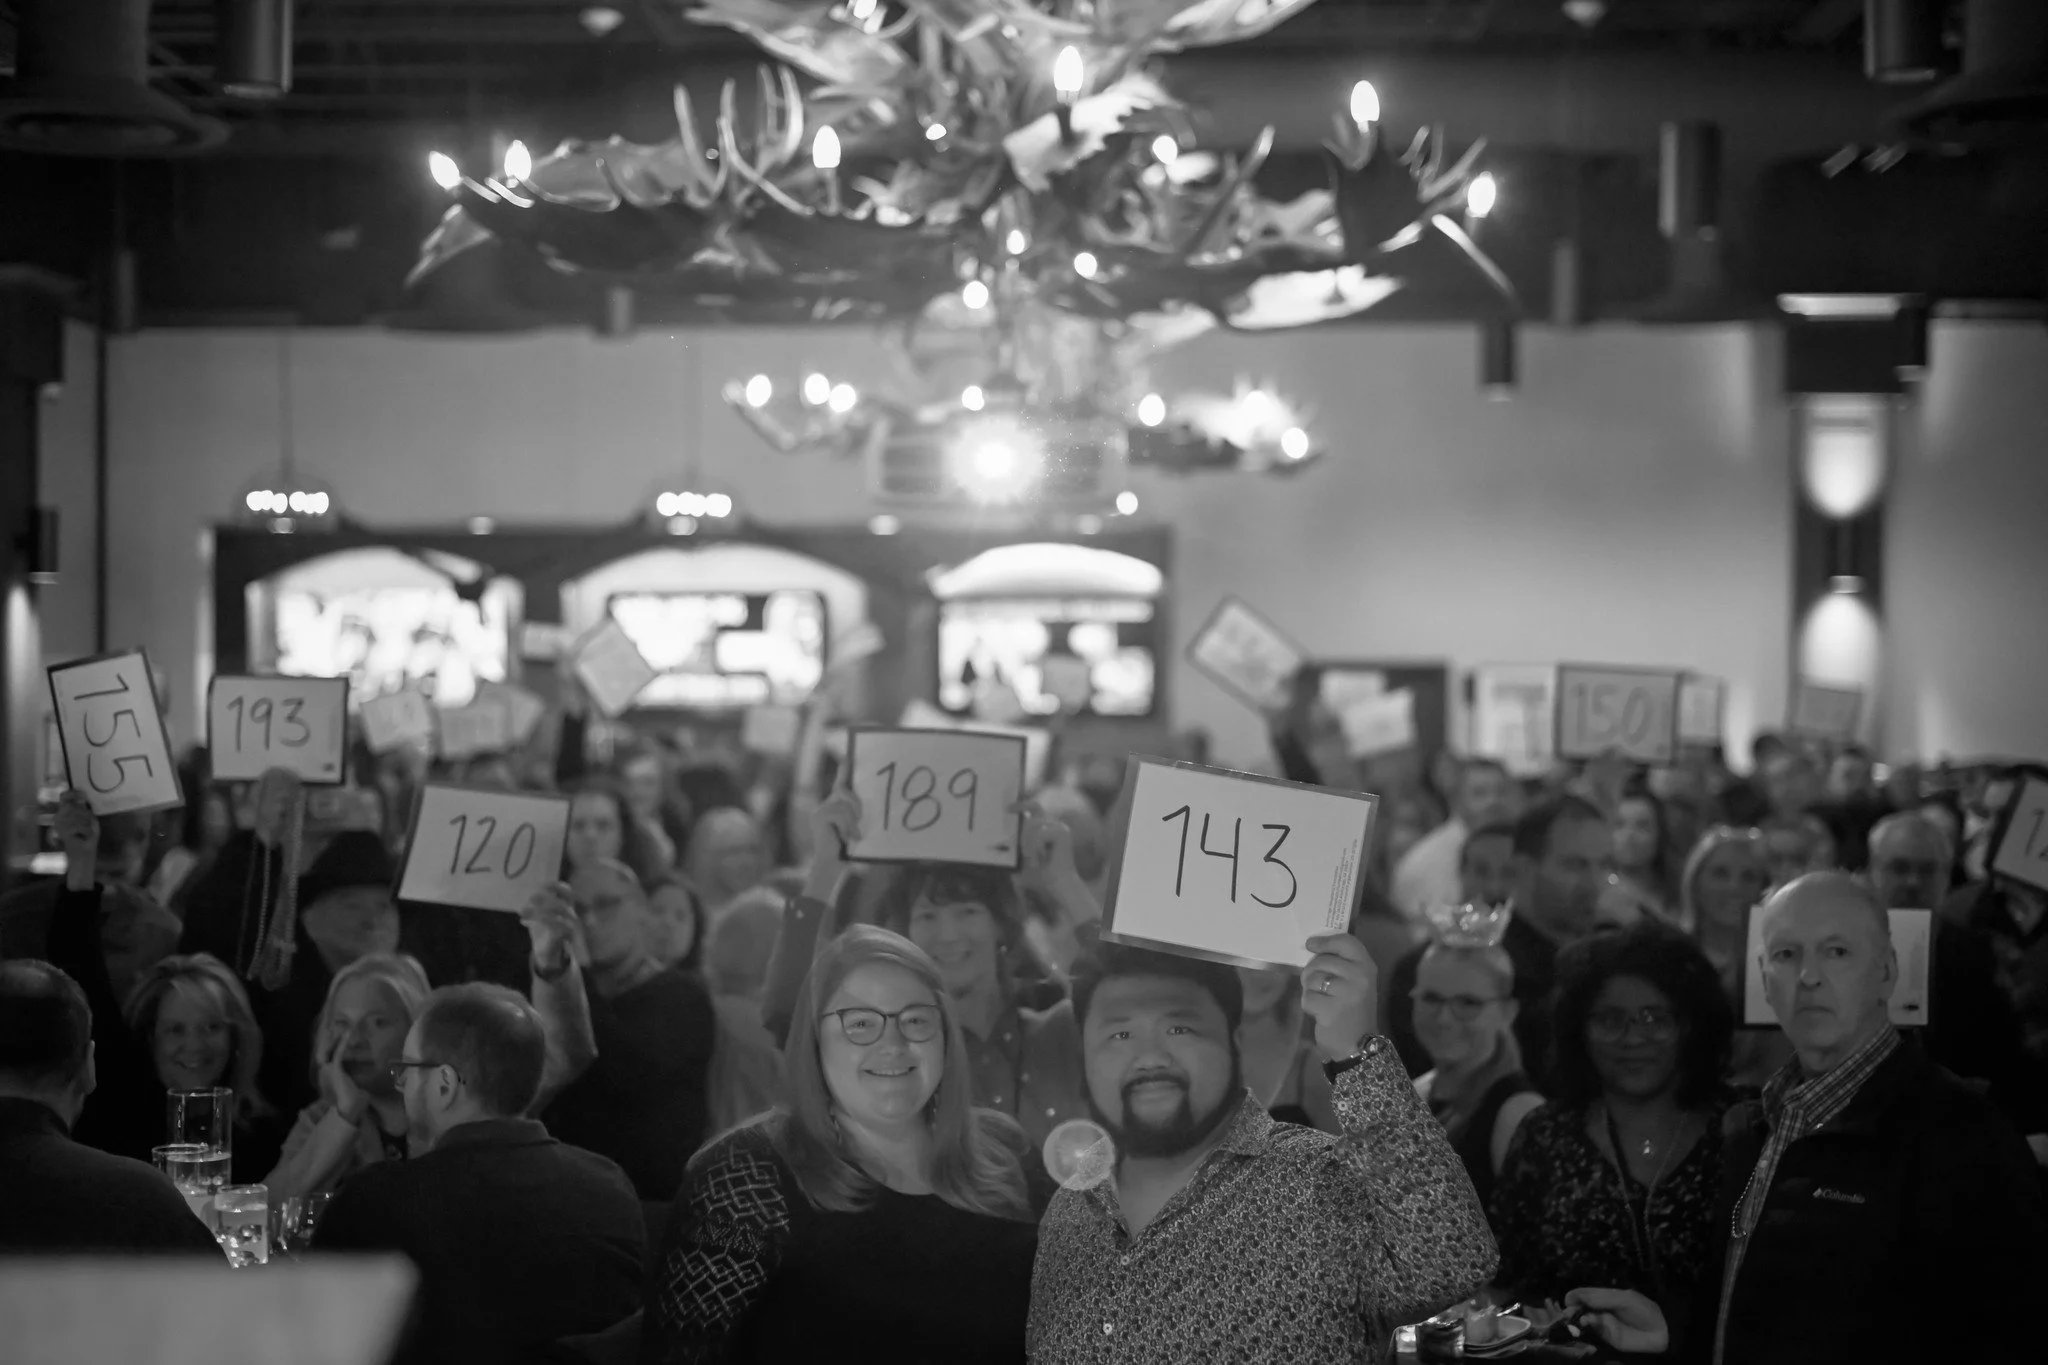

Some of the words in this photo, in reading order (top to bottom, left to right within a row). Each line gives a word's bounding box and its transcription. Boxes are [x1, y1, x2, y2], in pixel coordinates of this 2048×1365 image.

[73, 673, 154, 794] 155
[227, 695, 312, 753] 193
[1570, 682, 1654, 747] 150
[876, 761, 979, 833] 189
[448, 814, 537, 880] 120
[1162, 804, 1299, 909] 143
